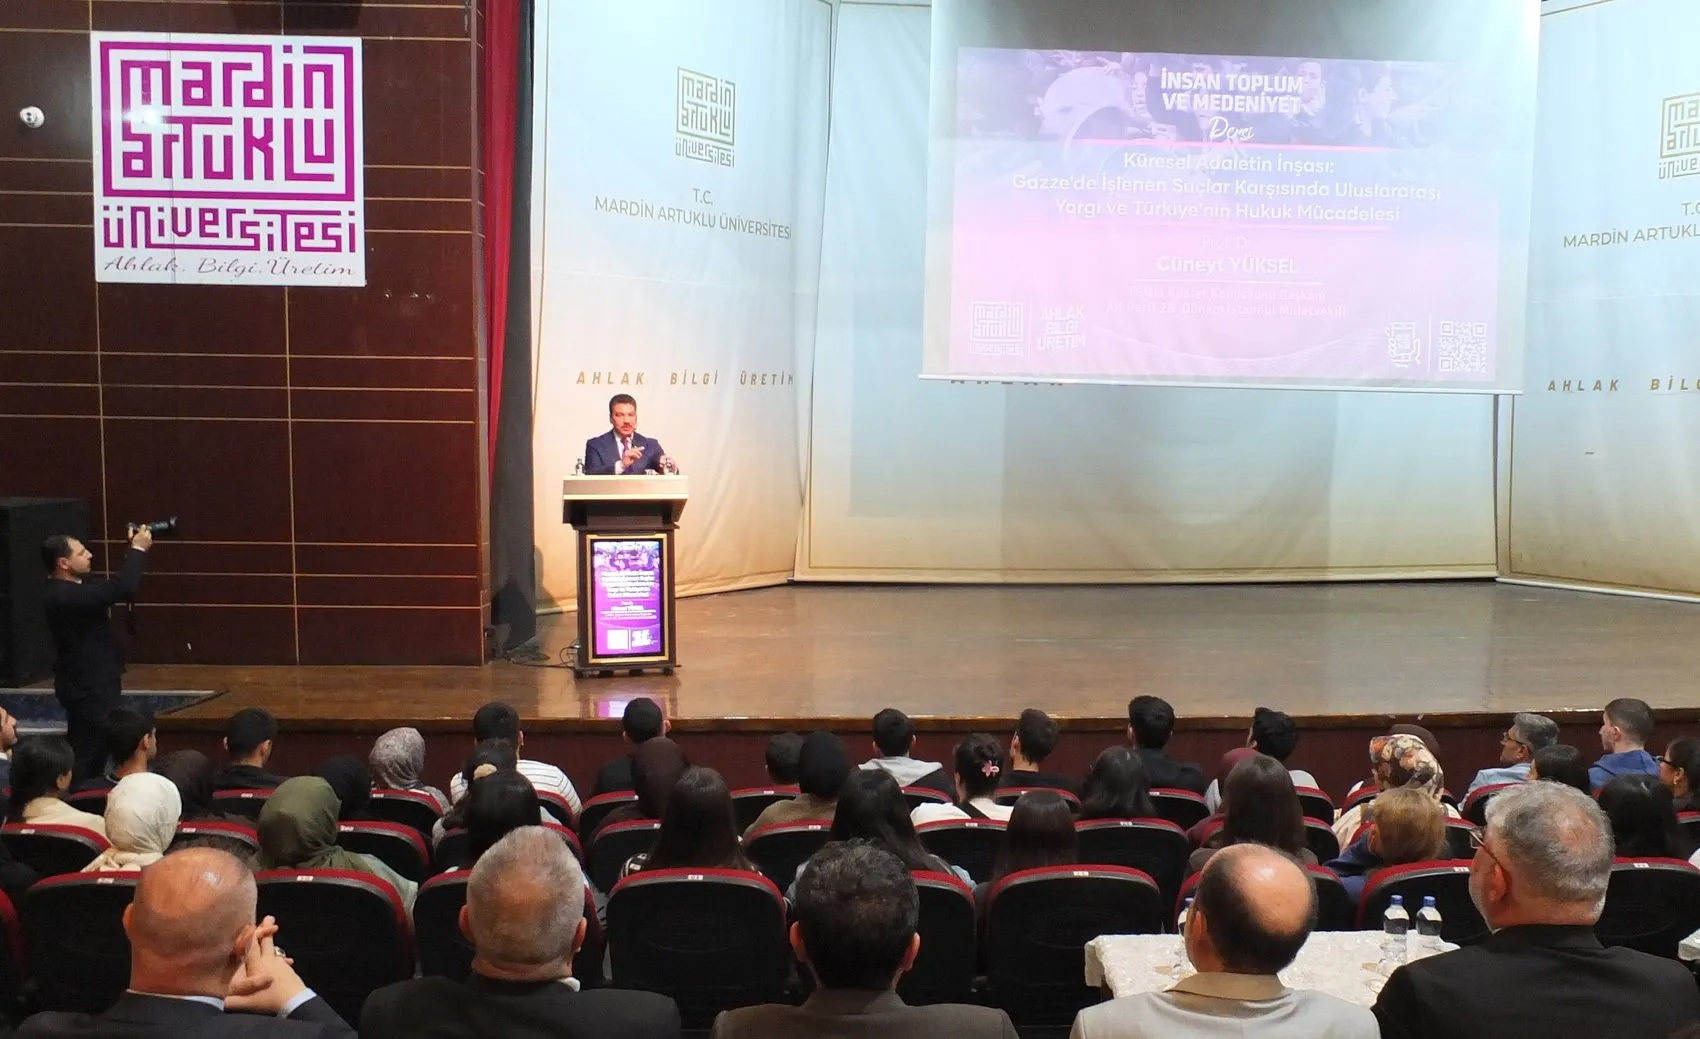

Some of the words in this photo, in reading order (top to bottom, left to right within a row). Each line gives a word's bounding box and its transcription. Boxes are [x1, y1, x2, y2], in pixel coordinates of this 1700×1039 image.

[1161, 67, 1221, 91] İNSAN
[1226, 73, 1304, 93] TOPLUM
[1162, 92, 1190, 111] VE
[1193, 91, 1302, 114] MEDENİYET
[1208, 116, 1255, 141] Dersi
[1123, 152, 1191, 170] Küresel
[1196, 154, 1273, 172] Adaletin
[1278, 153, 1335, 177] İnşası:
[693, 188, 713, 206] T.C.
[1012, 174, 1097, 191] Gazze'de
[1102, 172, 1167, 195] İşlenen
[1172, 178, 1230, 198] Suçlar
[1235, 179, 1330, 199] Karşısında
[1335, 182, 1441, 201] Uluslararası
[595, 195, 654, 219] MARDİN
[657, 206, 717, 229] ARTUKLU
[719, 212, 792, 240] ÜNİVERSİTESİ
[1056, 198, 1100, 218] Yargı
[1106, 204, 1128, 216] ve
[1133, 201, 1230, 220] Türkiye'nin
[1236, 204, 1292, 219] Hukuk
[1297, 205, 1400, 222] Mücadelesi
[103, 206, 356, 253] üniversitesi
[1563, 228, 1629, 248] MARDİN
[267, 256, 356, 276] Üretim
[1157, 255, 1225, 276] Cüneyt
[1229, 254, 1298, 274] YÜKSEL
[576, 371, 645, 385] AHLAK
[670, 369, 719, 386] BİLGİ
[1547, 379, 1619, 392] AHLAK
